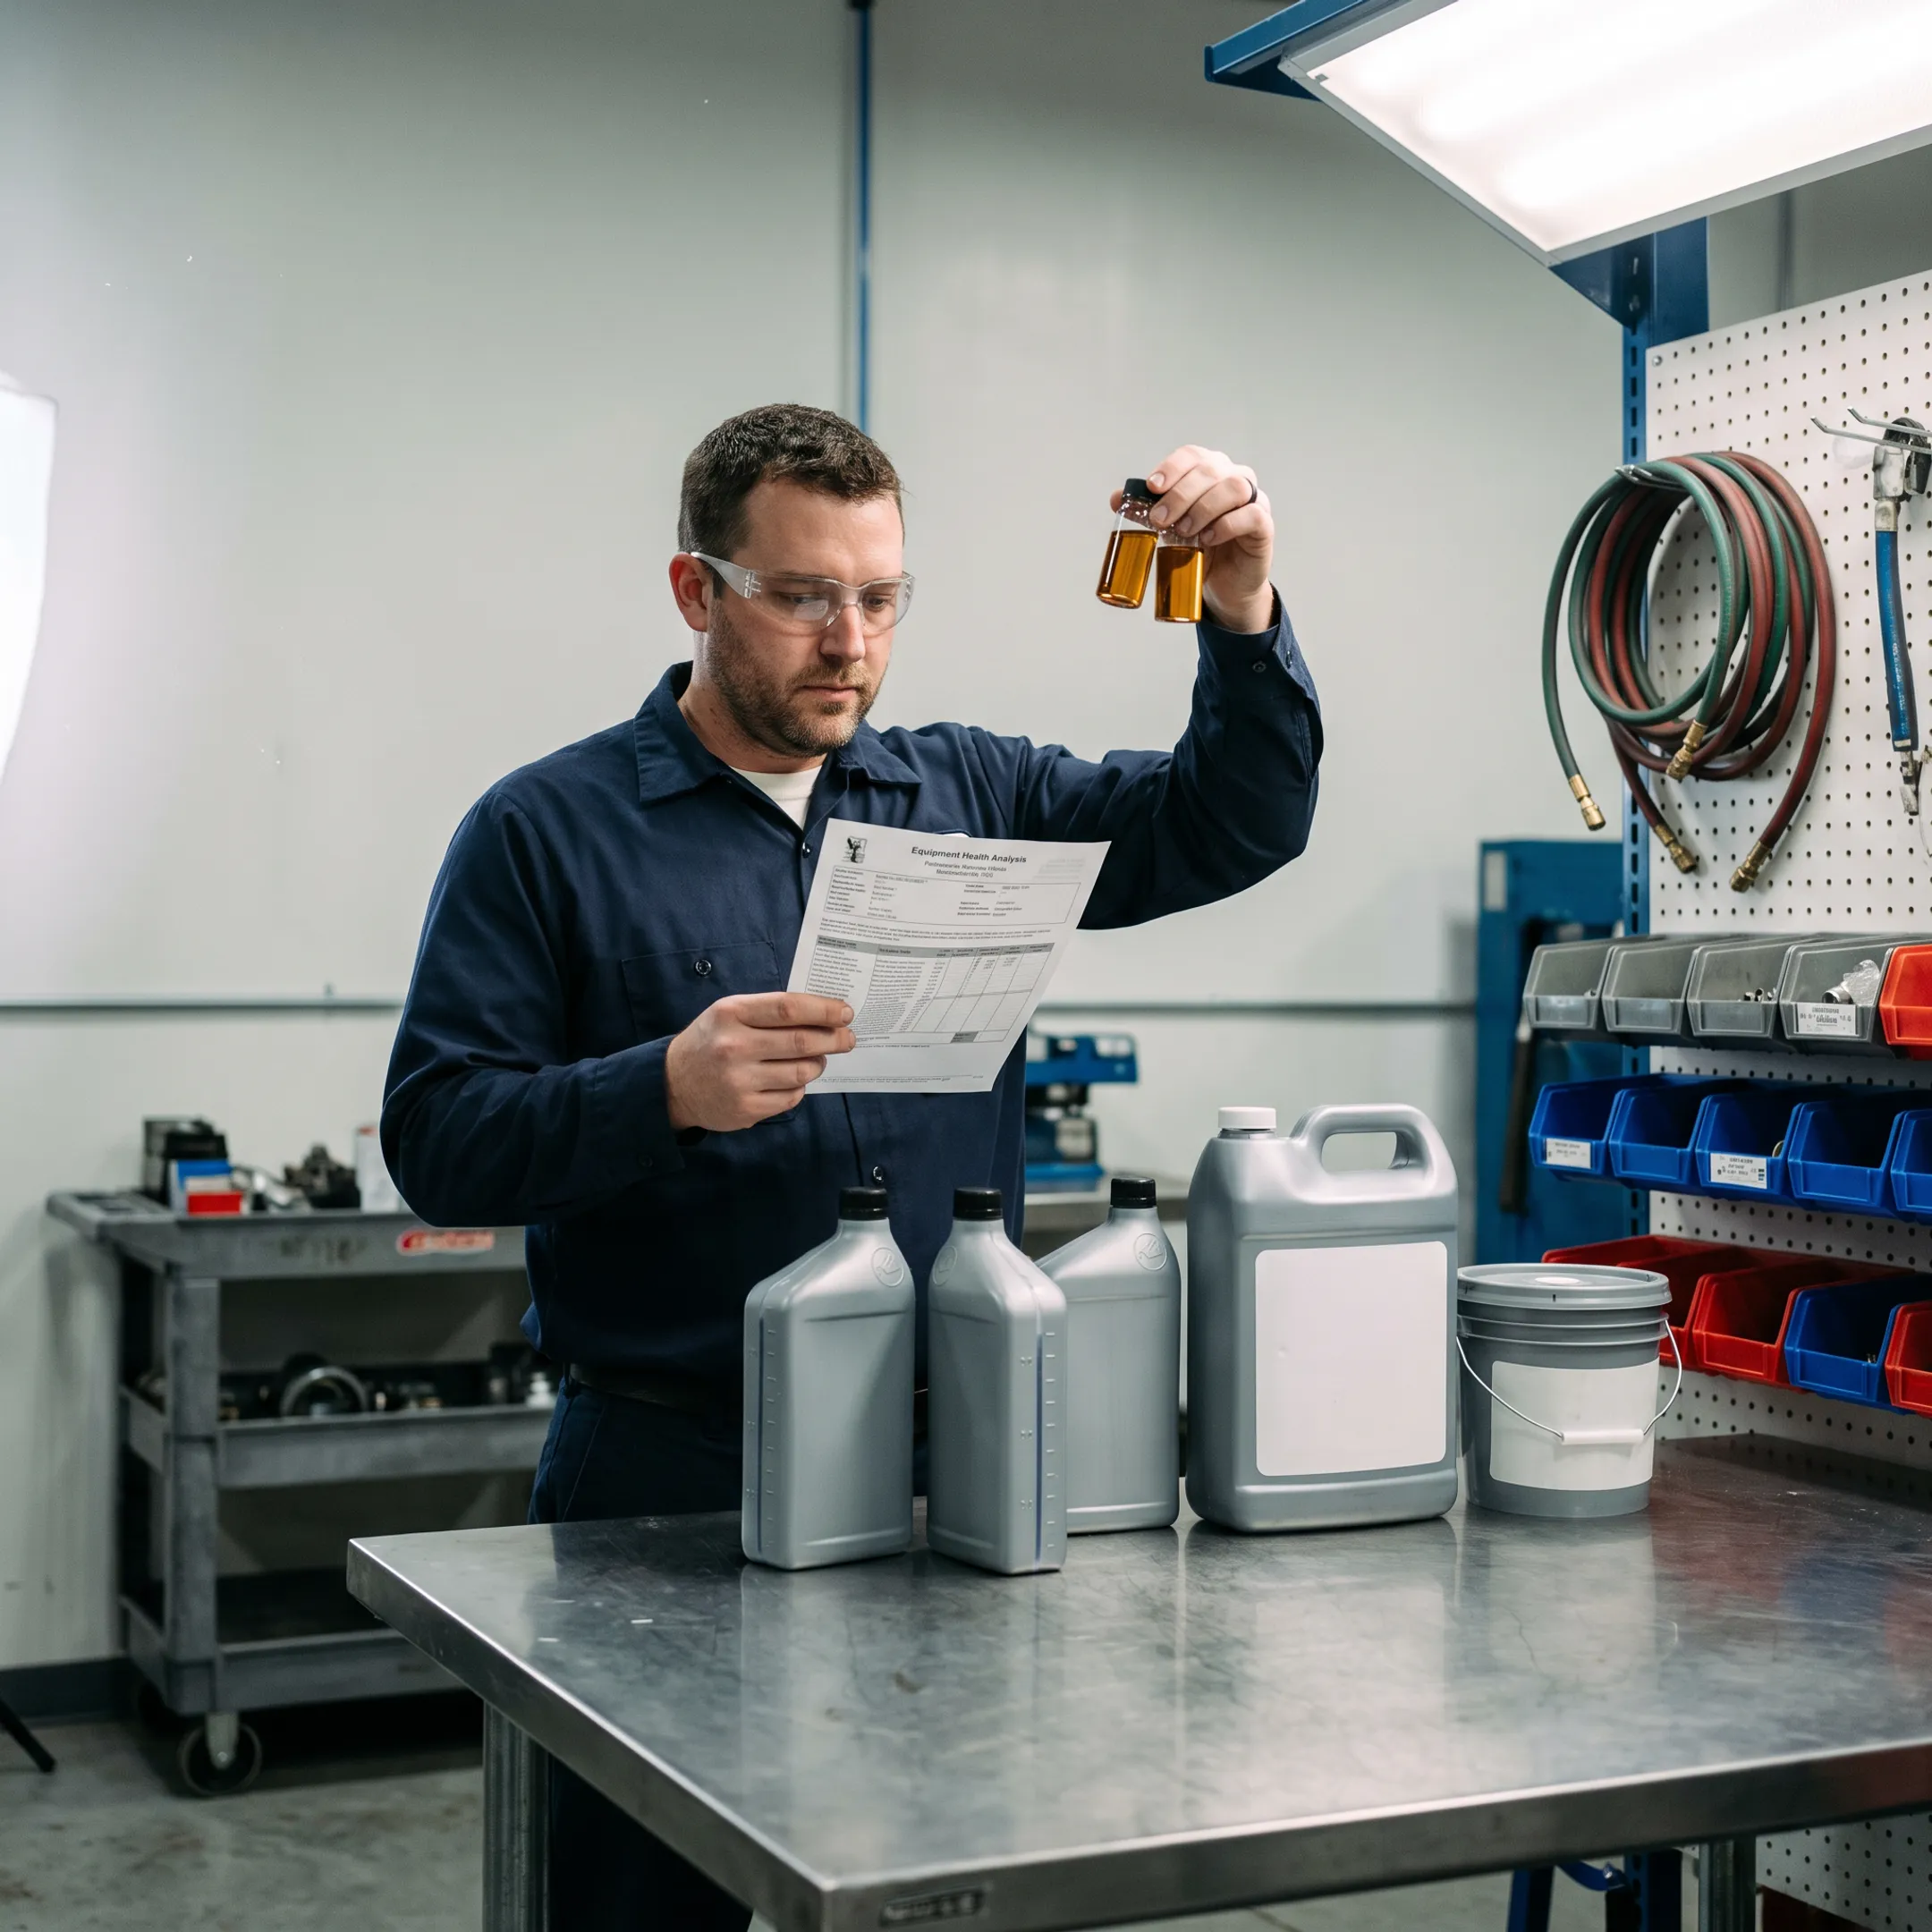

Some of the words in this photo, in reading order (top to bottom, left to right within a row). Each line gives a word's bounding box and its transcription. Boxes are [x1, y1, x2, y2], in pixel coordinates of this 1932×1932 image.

[911, 846, 961, 859] Equipment
[962, 852, 989, 861] Health
[991, 854, 1027, 864] Analysis
